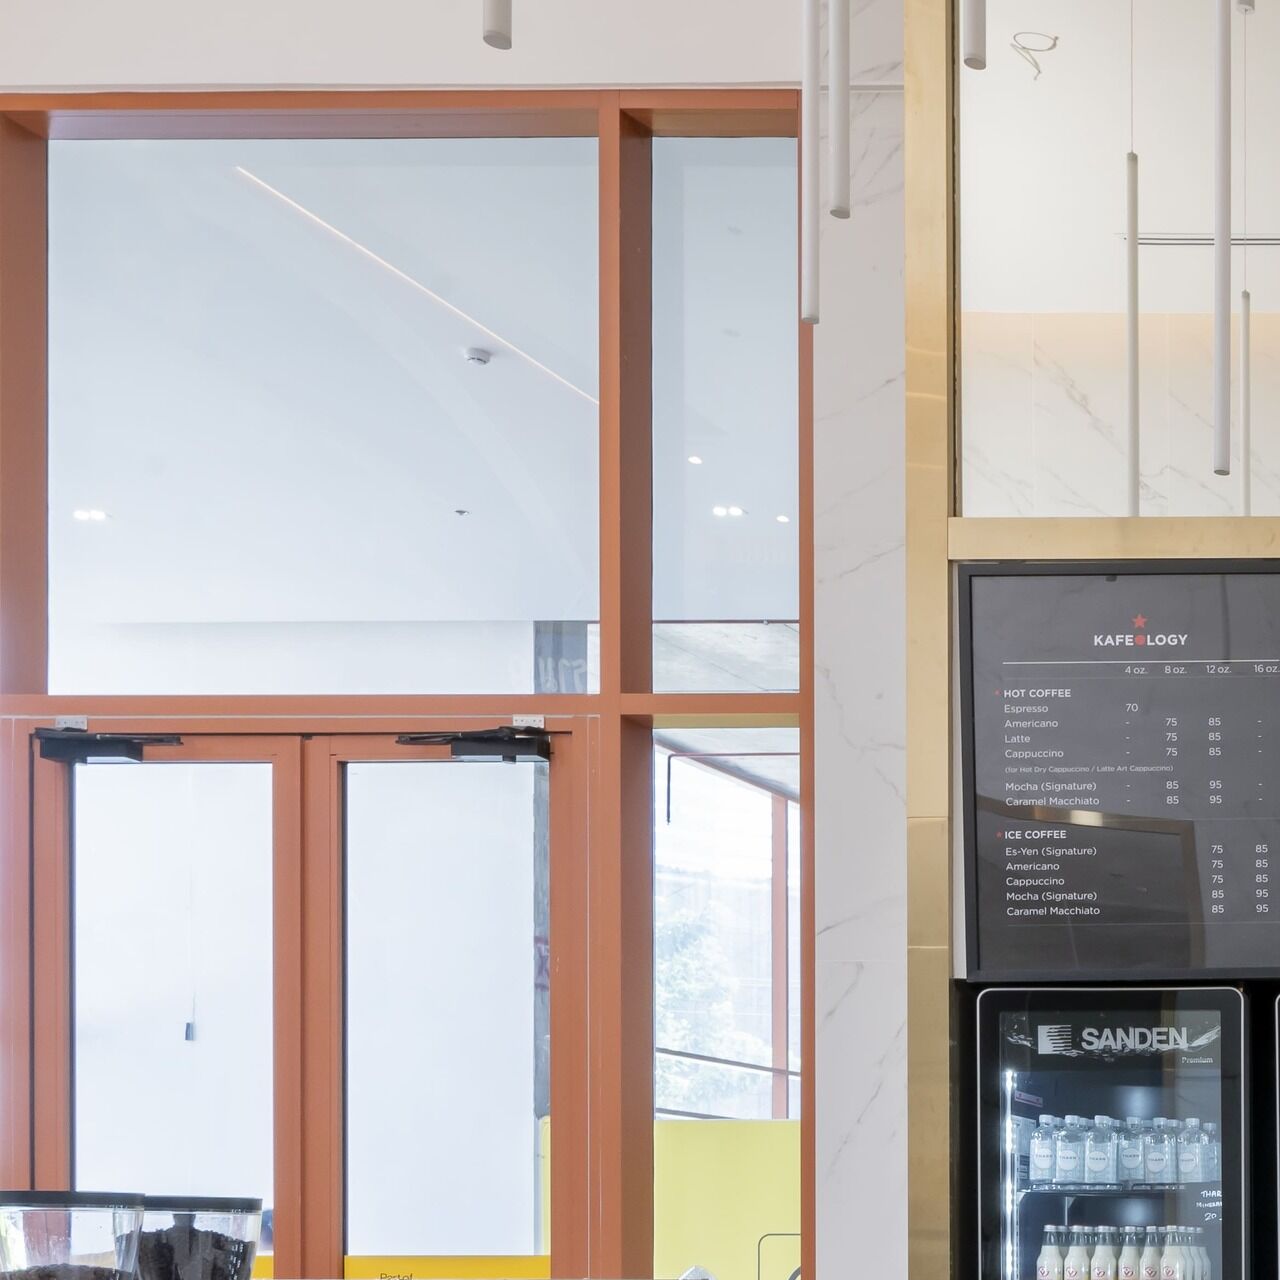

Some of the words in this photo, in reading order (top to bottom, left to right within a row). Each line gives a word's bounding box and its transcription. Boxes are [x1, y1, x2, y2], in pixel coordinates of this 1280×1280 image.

[1125, 666, 1132, 674] 4
[1165, 666, 1171, 674] 8
[1254, 665, 1263, 673] 16
[1004, 689, 1026, 698] HOT
[1029, 688, 1071, 698] COFFEE
[1004, 704, 1048, 715] Espresso
[1126, 704, 1139, 712] 70
[1004, 719, 1058, 728] Americano
[1165, 718, 1178, 727] 75
[1208, 717, 1221, 726] 85
[1004, 734, 1031, 743] Latte
[1165, 732, 1178, 742] 75
[1208, 732, 1221, 741] 85
[1005, 749, 1064, 760] Cappuccino
[1166, 748, 1178, 757] 75
[1208, 747, 1221, 756] 85
[1005, 782, 1038, 791] Mocha
[1041, 781, 1097, 792] (Signature)
[1166, 781, 1179, 790] 85
[1209, 780, 1222, 789] 95
[1006, 797, 1046, 806] Caramel
[1049, 796, 1100, 806] Macchiato
[1166, 795, 1179, 804] 85
[1209, 795, 1222, 804] 95
[1004, 830, 1021, 839] ICE
[1024, 830, 1067, 839] COFFEE
[1005, 847, 1039, 856] Es-Yen
[1041, 846, 1097, 857] (Signature)
[1211, 845, 1223, 854] 75
[1255, 844, 1268, 853] 85
[1006, 862, 1060, 871] Americano
[1211, 860, 1223, 869] 75
[1255, 859, 1268, 868] 85
[1006, 877, 1065, 887] Cappuccino
[1211, 875, 1223, 884] 75
[1255, 874, 1268, 883] 85
[1006, 892, 1039, 901] Mocha
[1041, 891, 1097, 902] (Signature)
[1211, 889, 1224, 898] 85
[1256, 889, 1269, 898] 95
[1006, 907, 1047, 916] Caramel
[1049, 906, 1100, 915] Macchiato
[1211, 905, 1225, 914] 85
[1256, 904, 1269, 913] 95
[1082, 1027, 1188, 1050] SANDEN
